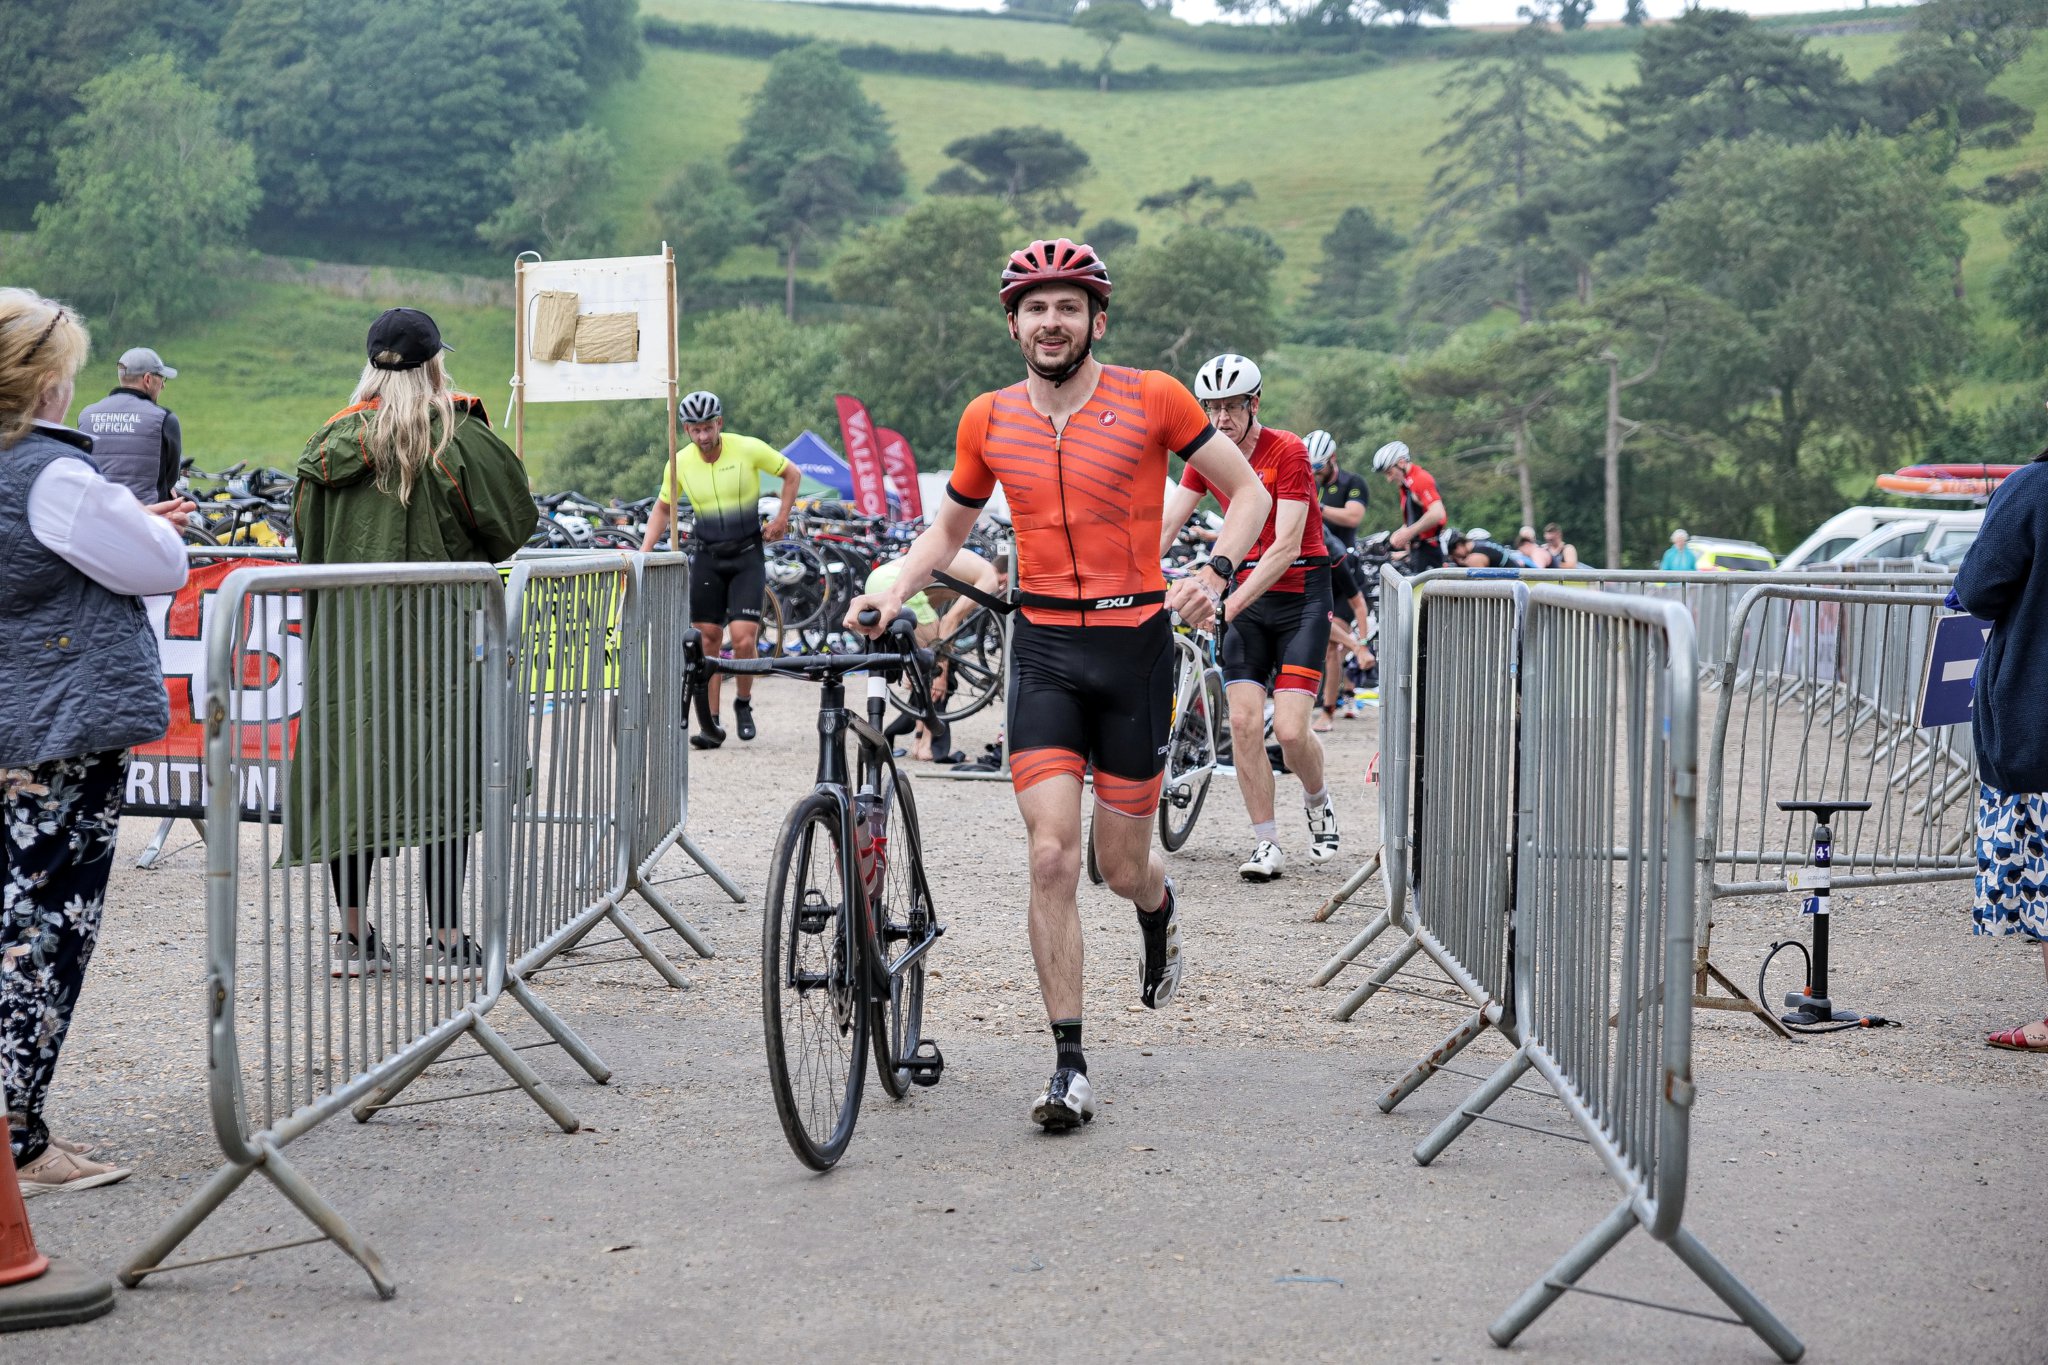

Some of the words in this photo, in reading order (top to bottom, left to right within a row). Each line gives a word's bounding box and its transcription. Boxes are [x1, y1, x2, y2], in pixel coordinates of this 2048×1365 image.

[90, 413, 142, 423] TECHNICAL
[92, 422, 136, 433] OFFICIAL
[1095, 596, 1134, 610] 2XU
[125, 760, 277, 812] RITN
[1816, 846, 1831, 859] 41
